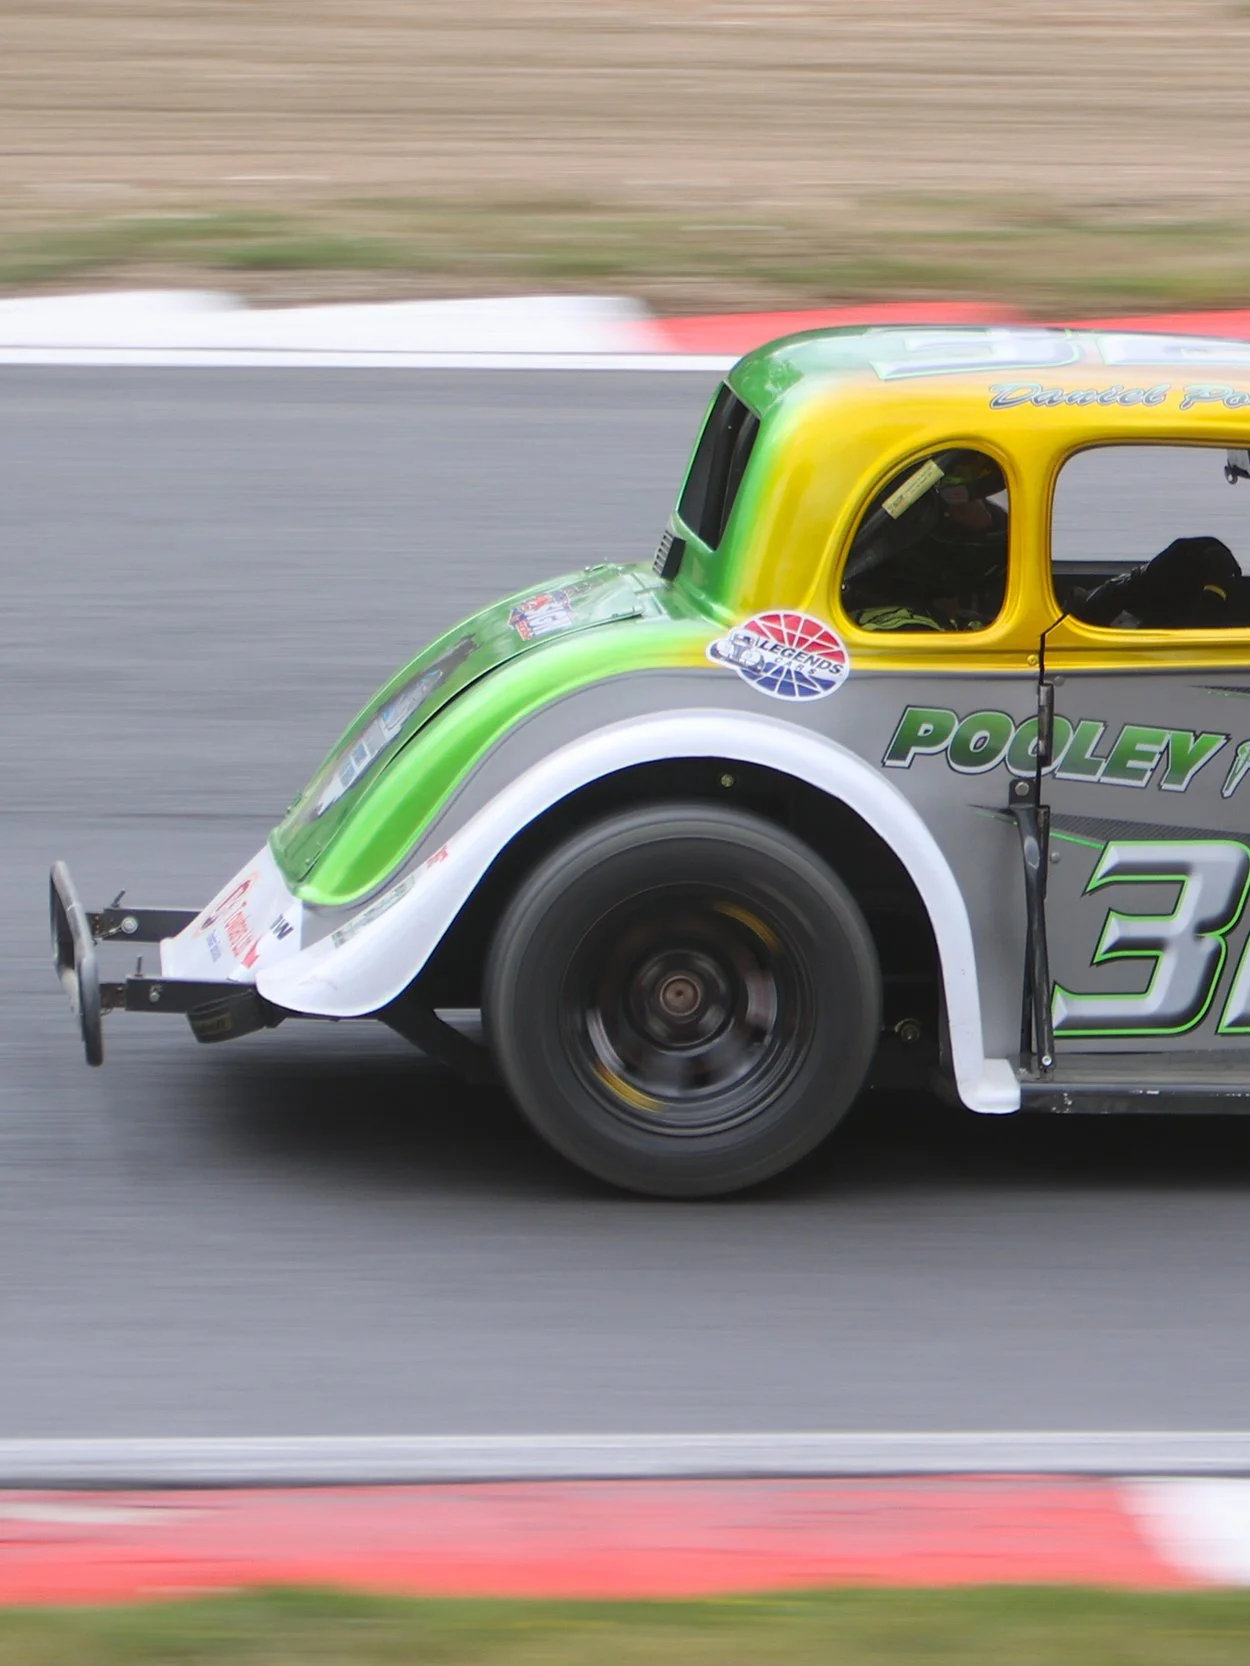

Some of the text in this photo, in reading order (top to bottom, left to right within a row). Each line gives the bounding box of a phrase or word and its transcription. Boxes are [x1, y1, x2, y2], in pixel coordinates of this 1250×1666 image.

[989, 382, 1170, 410] Daniel
[760, 640, 843, 675] LEGENDS
[774, 657, 817, 675] CARS
[882, 705, 1231, 792] POOLEY
